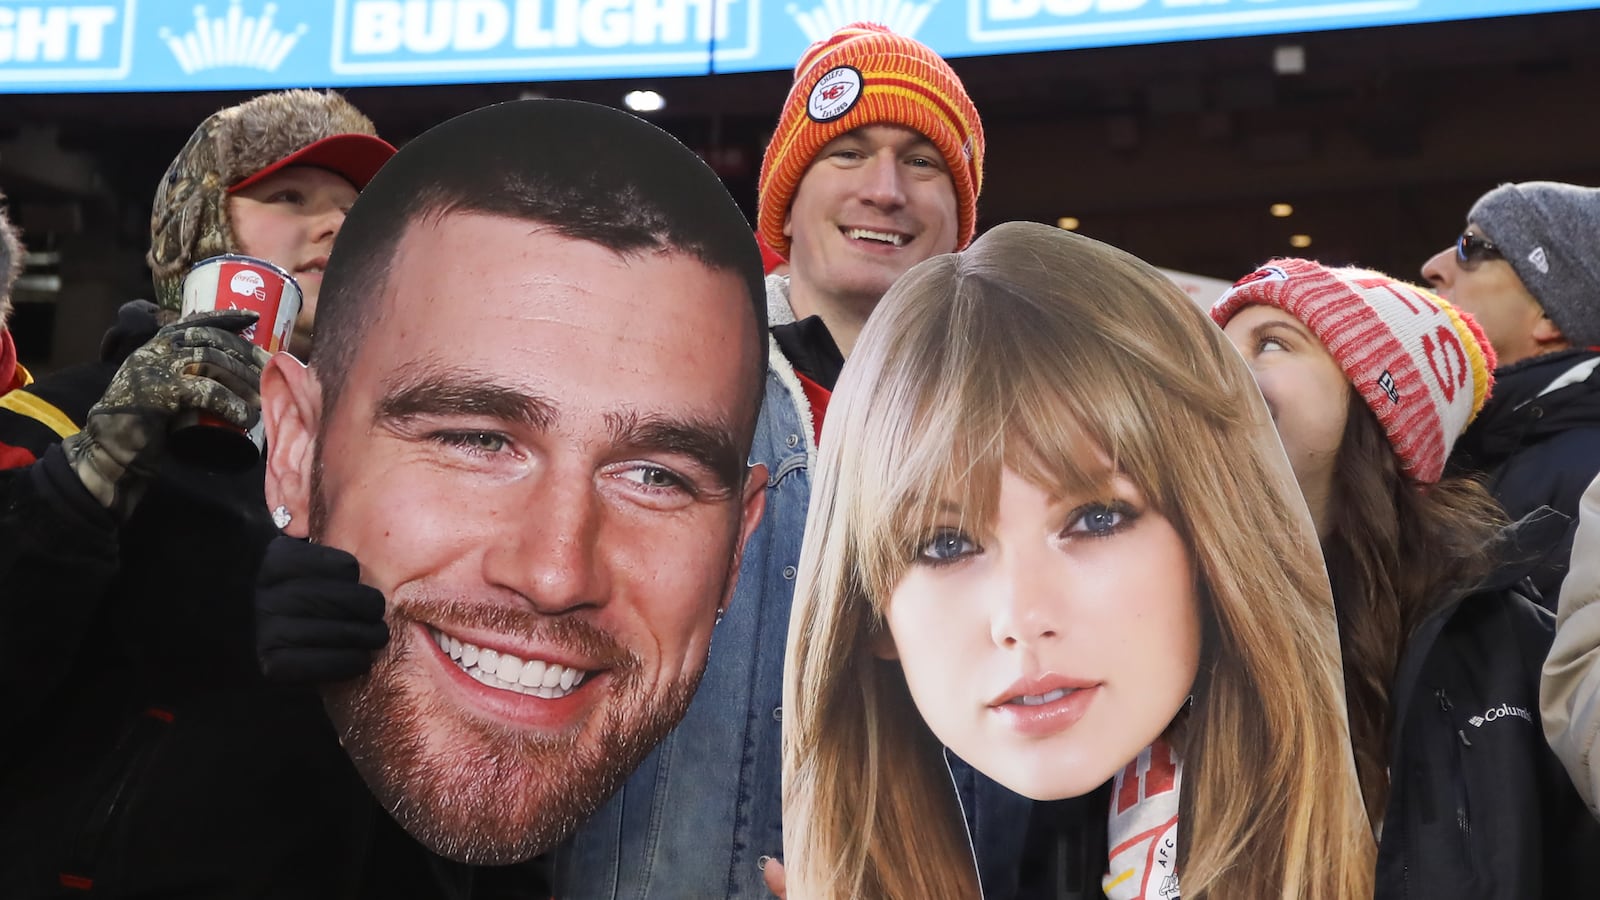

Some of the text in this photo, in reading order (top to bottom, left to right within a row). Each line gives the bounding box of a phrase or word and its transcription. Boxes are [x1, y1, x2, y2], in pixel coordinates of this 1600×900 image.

[351, 0, 737, 54] BUD LIGHT
[820, 70, 844, 86] CHIEFS
[1158, 838, 1174, 868] AFC
